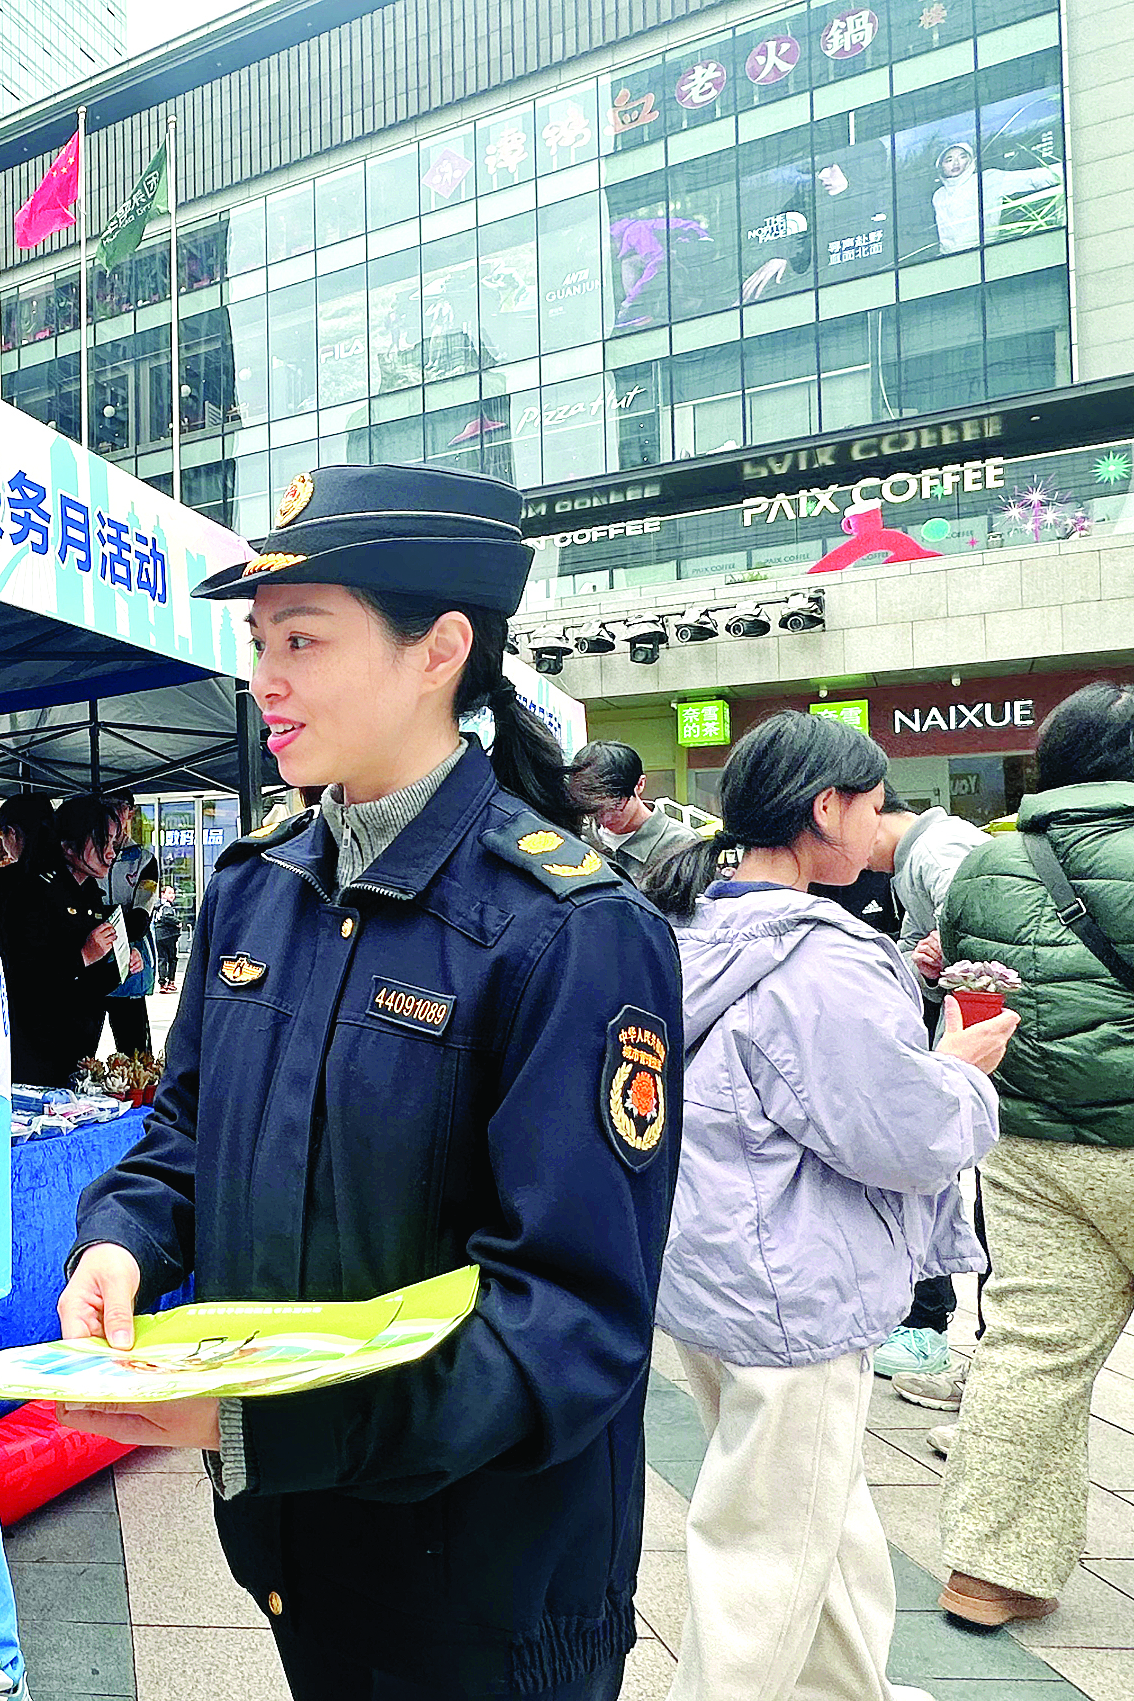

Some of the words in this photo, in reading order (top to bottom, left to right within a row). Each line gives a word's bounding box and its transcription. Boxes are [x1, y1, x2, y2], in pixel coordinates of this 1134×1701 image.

[321, 339, 364, 364] FILA
[515, 402, 586, 434] Pizza
[584, 384, 647, 416] Hut
[742, 483, 840, 527] PAIX
[851, 457, 1005, 506] COFFEE
[554, 516, 661, 548] COFFEE
[682, 705, 719, 723] 奈雪
[683, 722, 719, 738] 的茶
[893, 699, 1034, 733] NAIXUE
[374, 987, 447, 1025] 44091089
